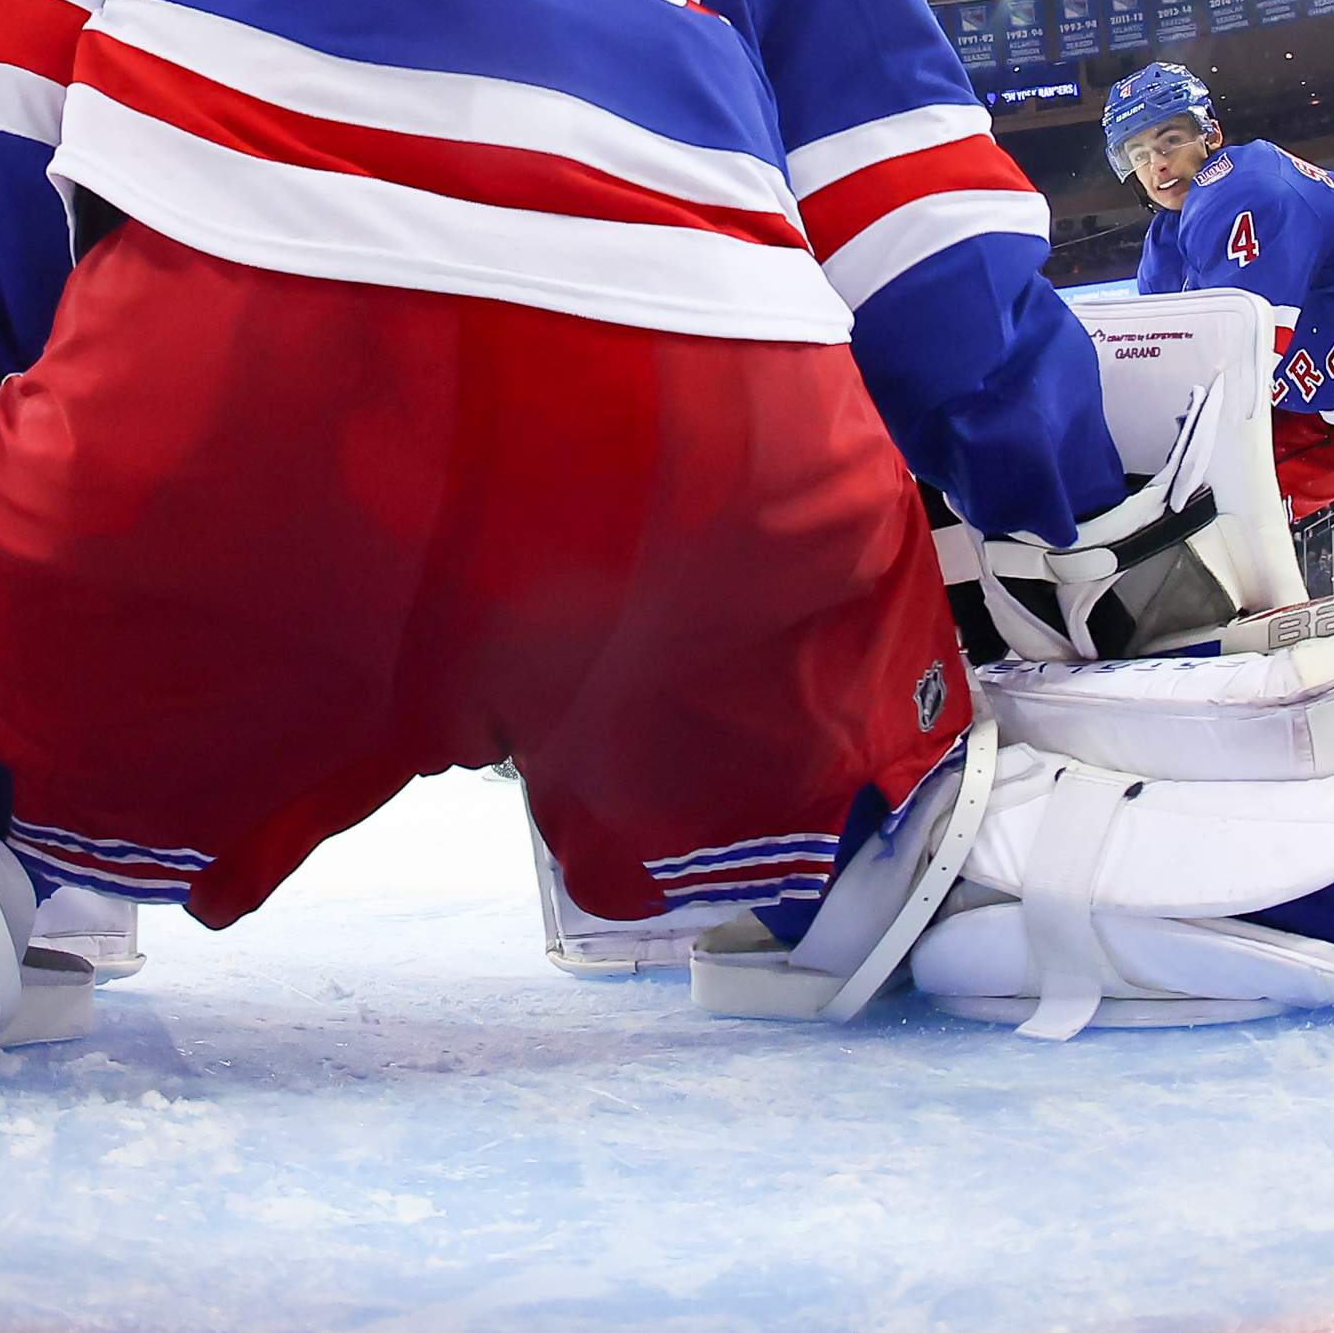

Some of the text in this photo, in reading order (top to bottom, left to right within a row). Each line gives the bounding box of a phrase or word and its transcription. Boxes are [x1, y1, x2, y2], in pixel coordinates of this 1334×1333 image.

[1116, 103, 1145, 123] BAUER
[1227, 210, 1260, 268] 4
[1114, 346, 1161, 360] GARAND
